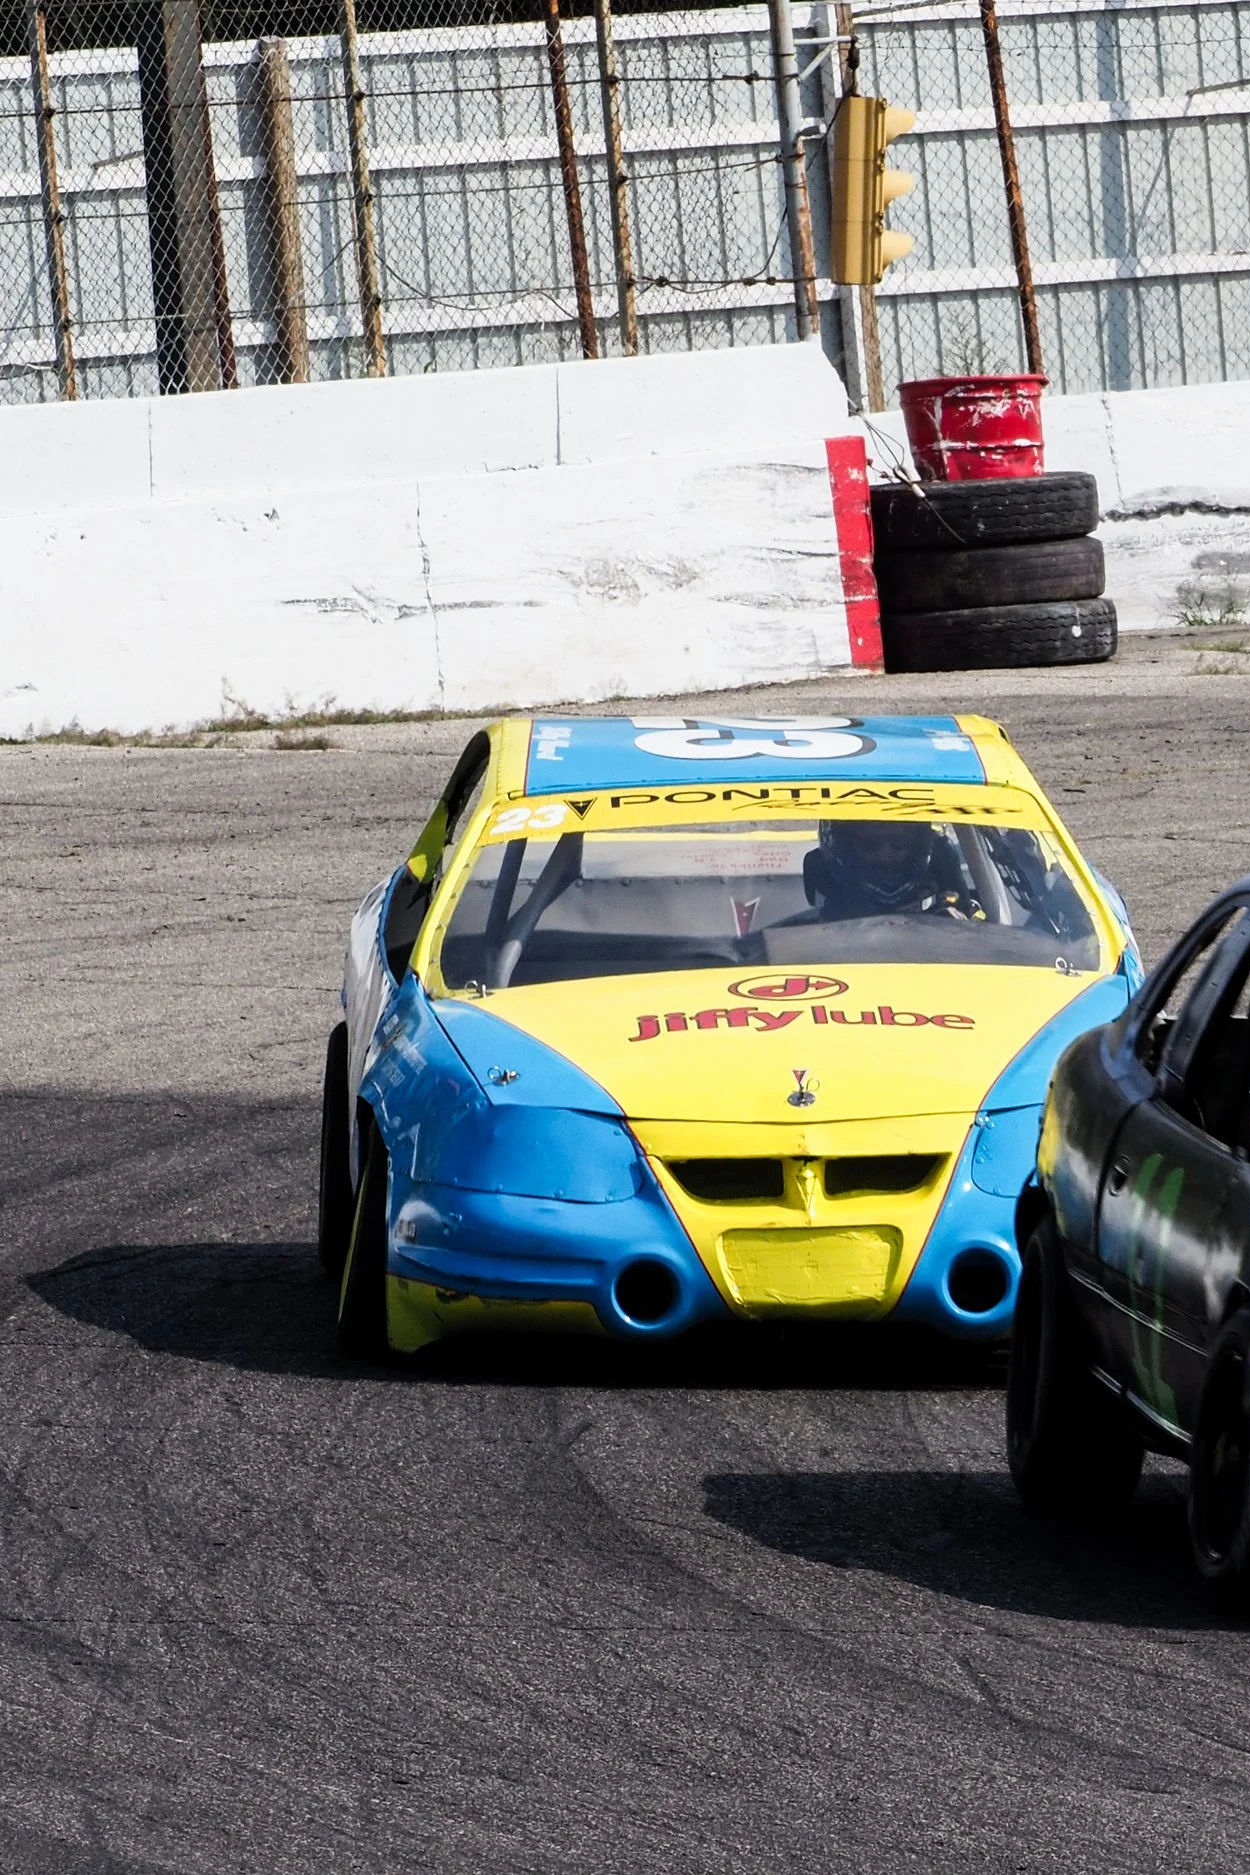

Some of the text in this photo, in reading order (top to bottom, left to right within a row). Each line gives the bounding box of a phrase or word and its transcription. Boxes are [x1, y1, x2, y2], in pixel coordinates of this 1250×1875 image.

[610, 788, 935, 808] PONTIAC
[489, 803, 568, 835] 23
[628, 1005, 976, 1042] jiffy lube
